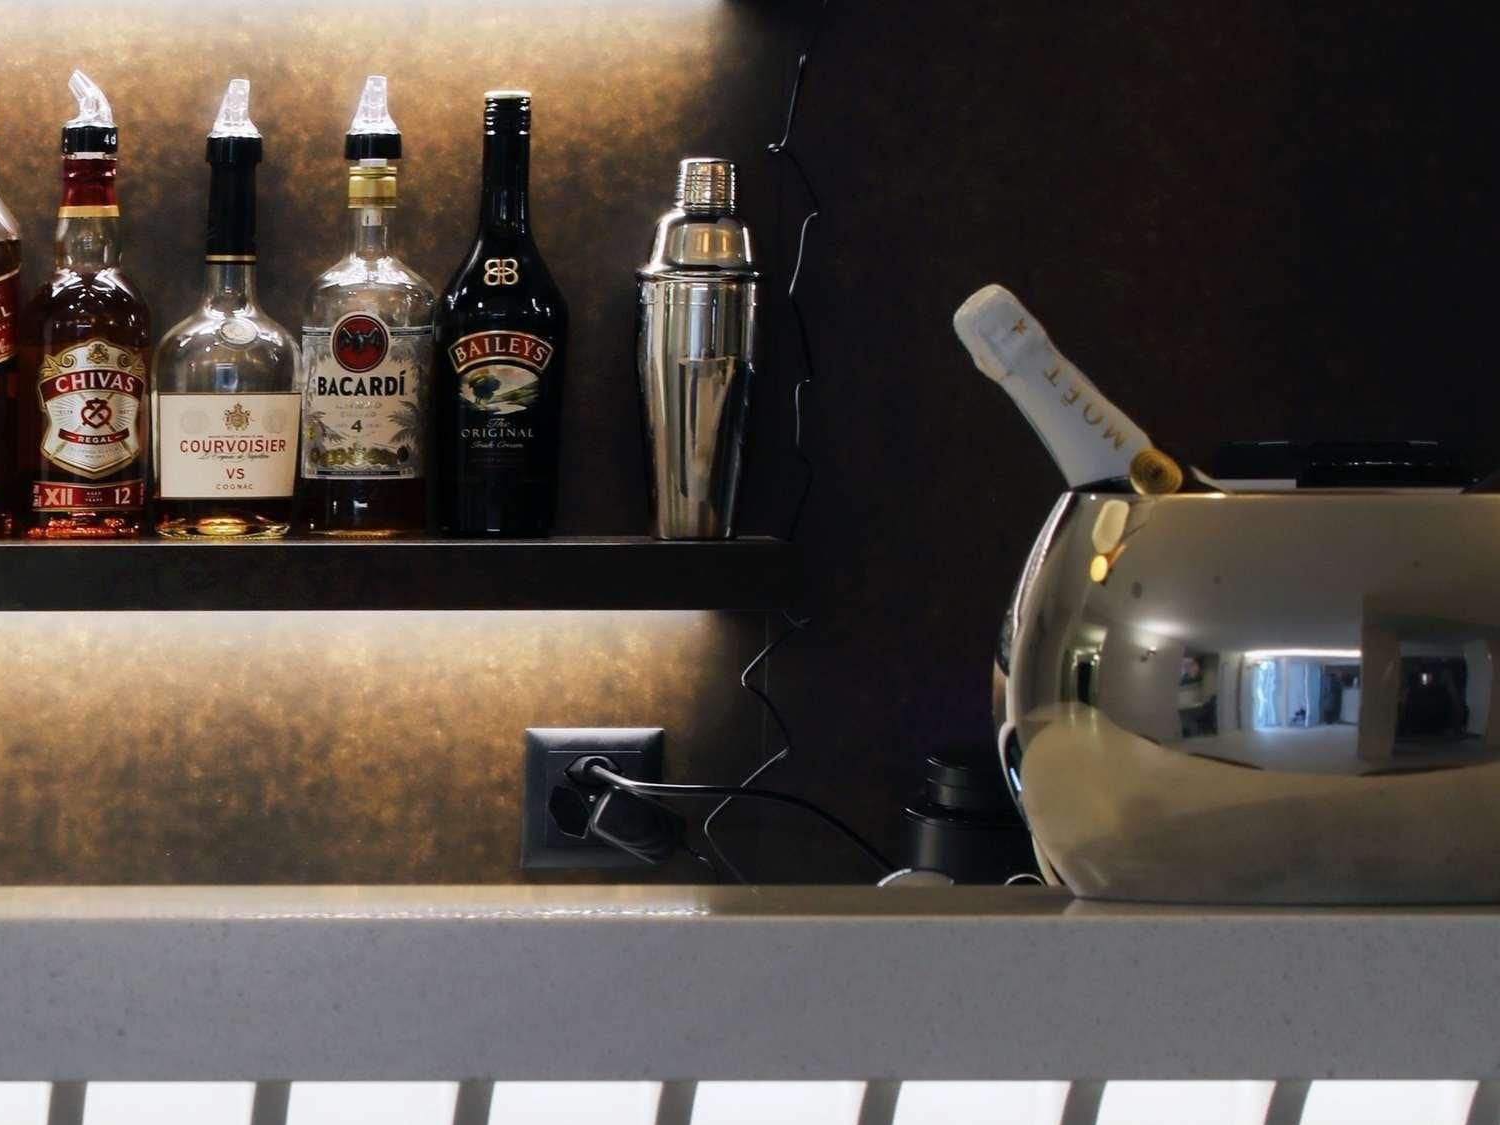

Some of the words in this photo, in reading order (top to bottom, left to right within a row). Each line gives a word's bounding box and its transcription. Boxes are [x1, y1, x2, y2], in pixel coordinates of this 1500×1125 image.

[454, 337, 548, 364] BAILEYS
[55, 371, 135, 393] CHIVAS
[351, 419, 363, 433] 4
[460, 428, 535, 438] ORIGINAL
[77, 434, 114, 444] REGAL
[180, 438, 286, 454] COURVOISIER
[226, 467, 245, 480] VS
[44, 487, 73, 506] XII
[114, 487, 131, 505] 12
